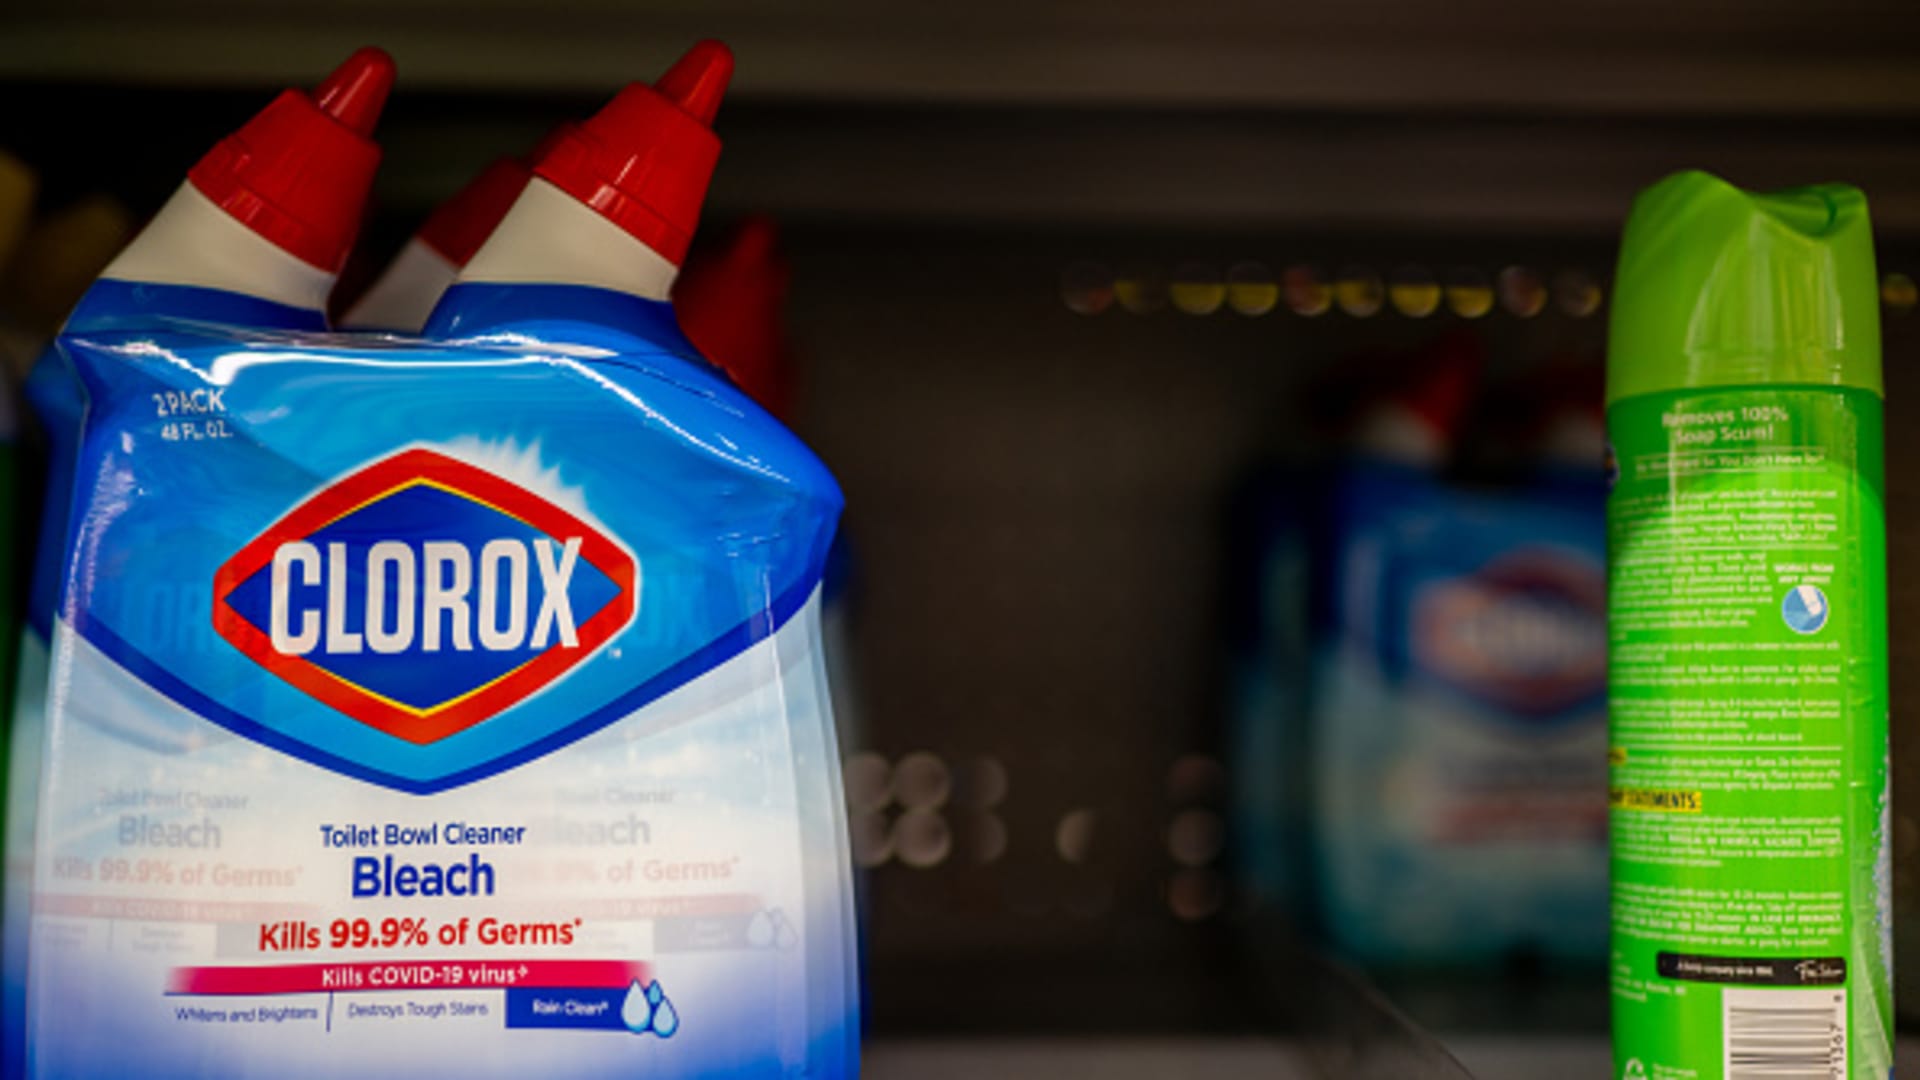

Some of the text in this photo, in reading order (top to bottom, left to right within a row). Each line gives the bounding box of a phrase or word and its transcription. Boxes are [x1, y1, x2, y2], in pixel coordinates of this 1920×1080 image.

[1675, 424, 1775, 445] Soap Scum!
[271, 536, 584, 657] CLORO[1627,757,1842,789]
[117, 814, 222, 849] Bleach
[319, 822, 527, 848] Toilet Bowl Cleaner
[99, 857, 174, 884] 99.9%
[180, 862, 206, 886] of
[351, 852, 495, 899] Bleach
[258, 921, 321, 952] Kills
[329, 917, 429, 949] 99.9%
[438, 917, 470, 946] of
[322, 967, 363, 988] Kills
[368, 965, 463, 987] COVID-19
[175, 1005, 319, 1025] Whitens and Brightens
[348, 1000, 489, 1019] Destroys Tough Stains
